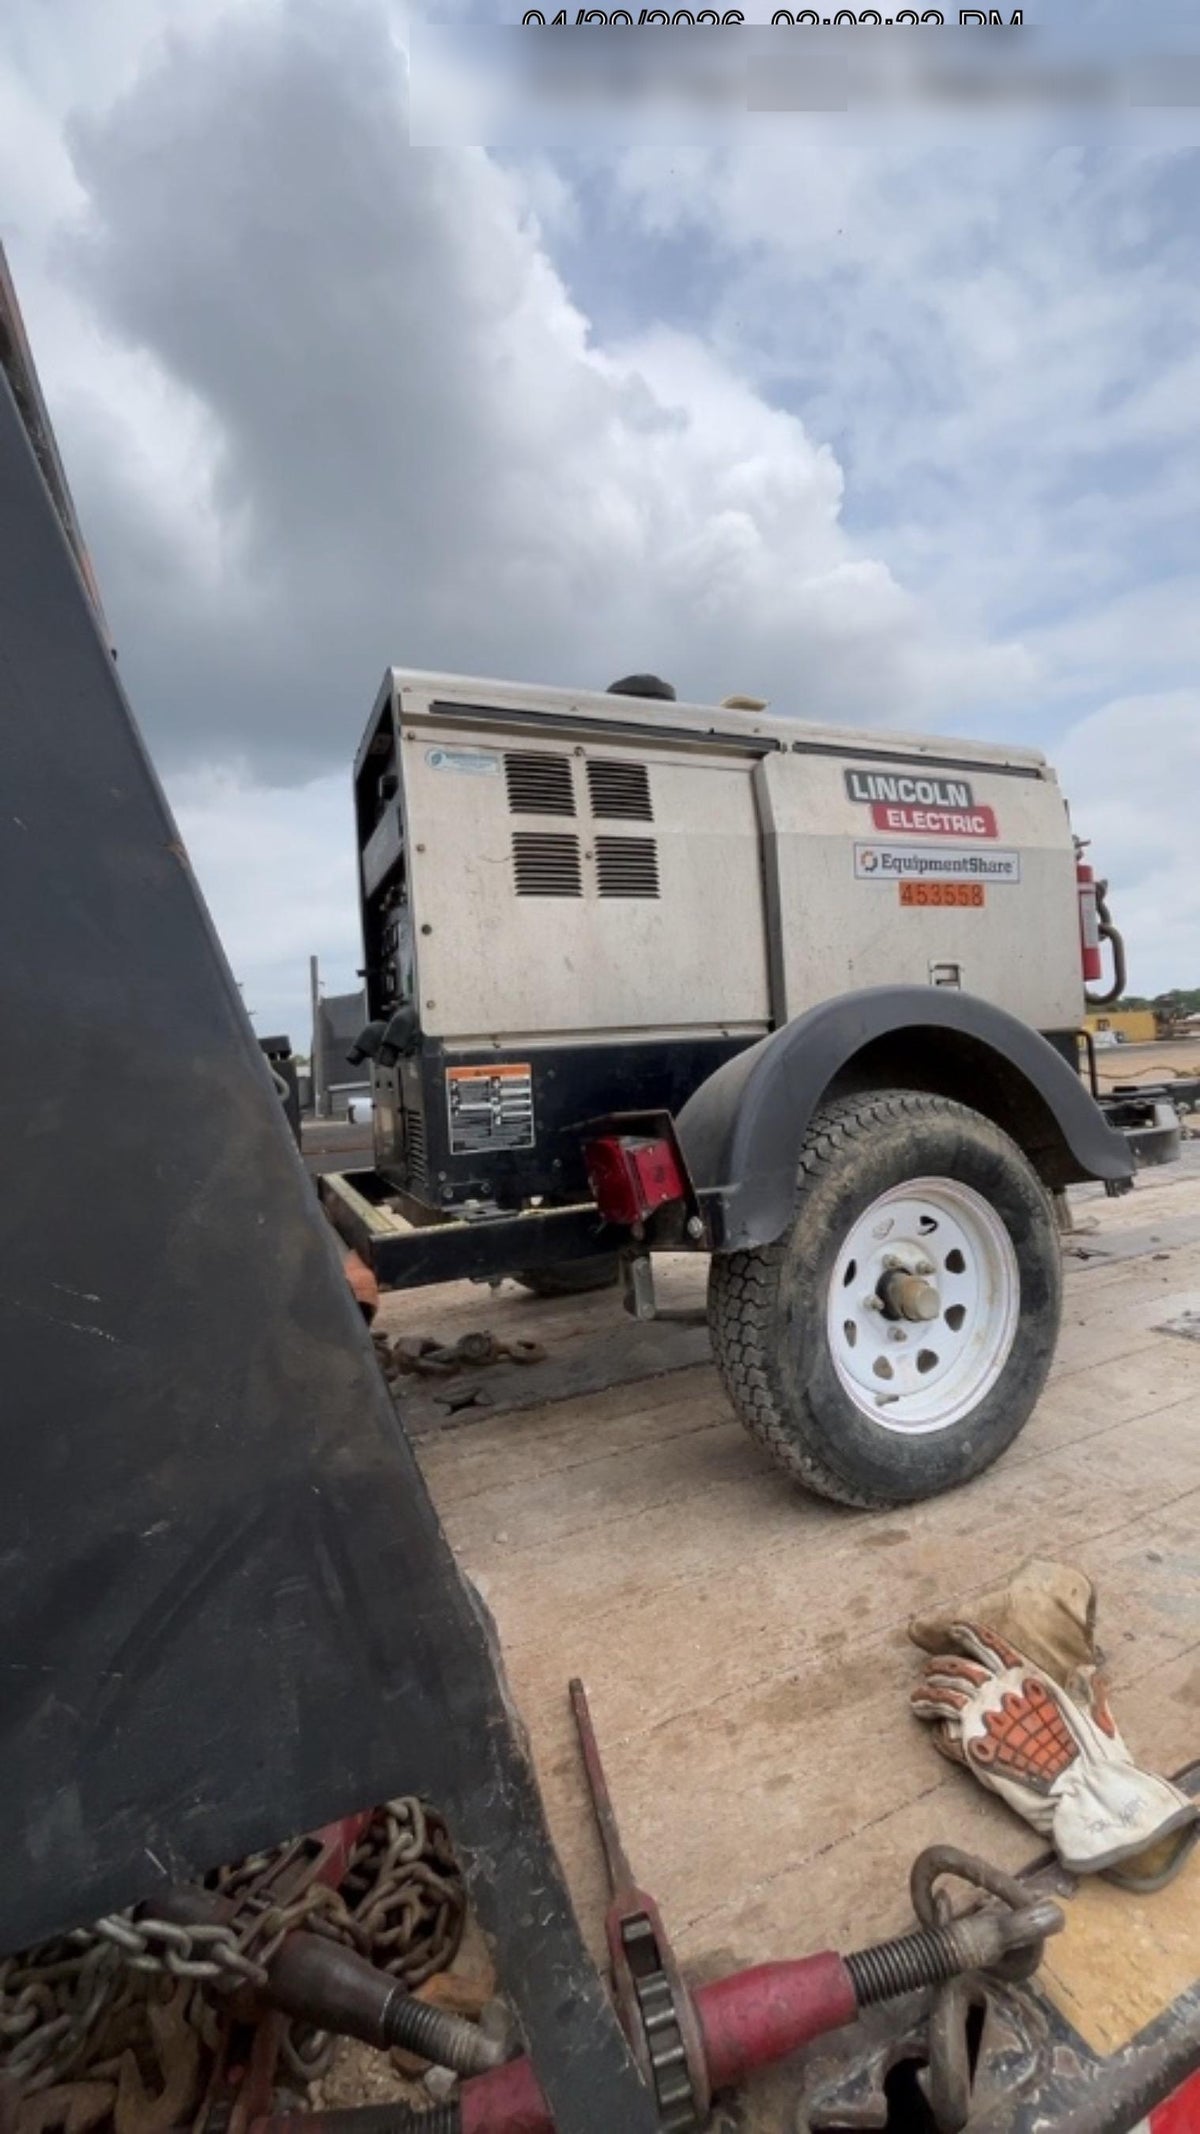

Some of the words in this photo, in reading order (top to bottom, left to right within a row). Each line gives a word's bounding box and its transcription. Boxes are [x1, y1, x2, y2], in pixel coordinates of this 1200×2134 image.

[851, 774, 969, 807] LINCOLN
[886, 810, 987, 833] ELECTRIC
[881, 853, 1013, 875] EquipmentShare
[901, 884, 983, 906] 453558
